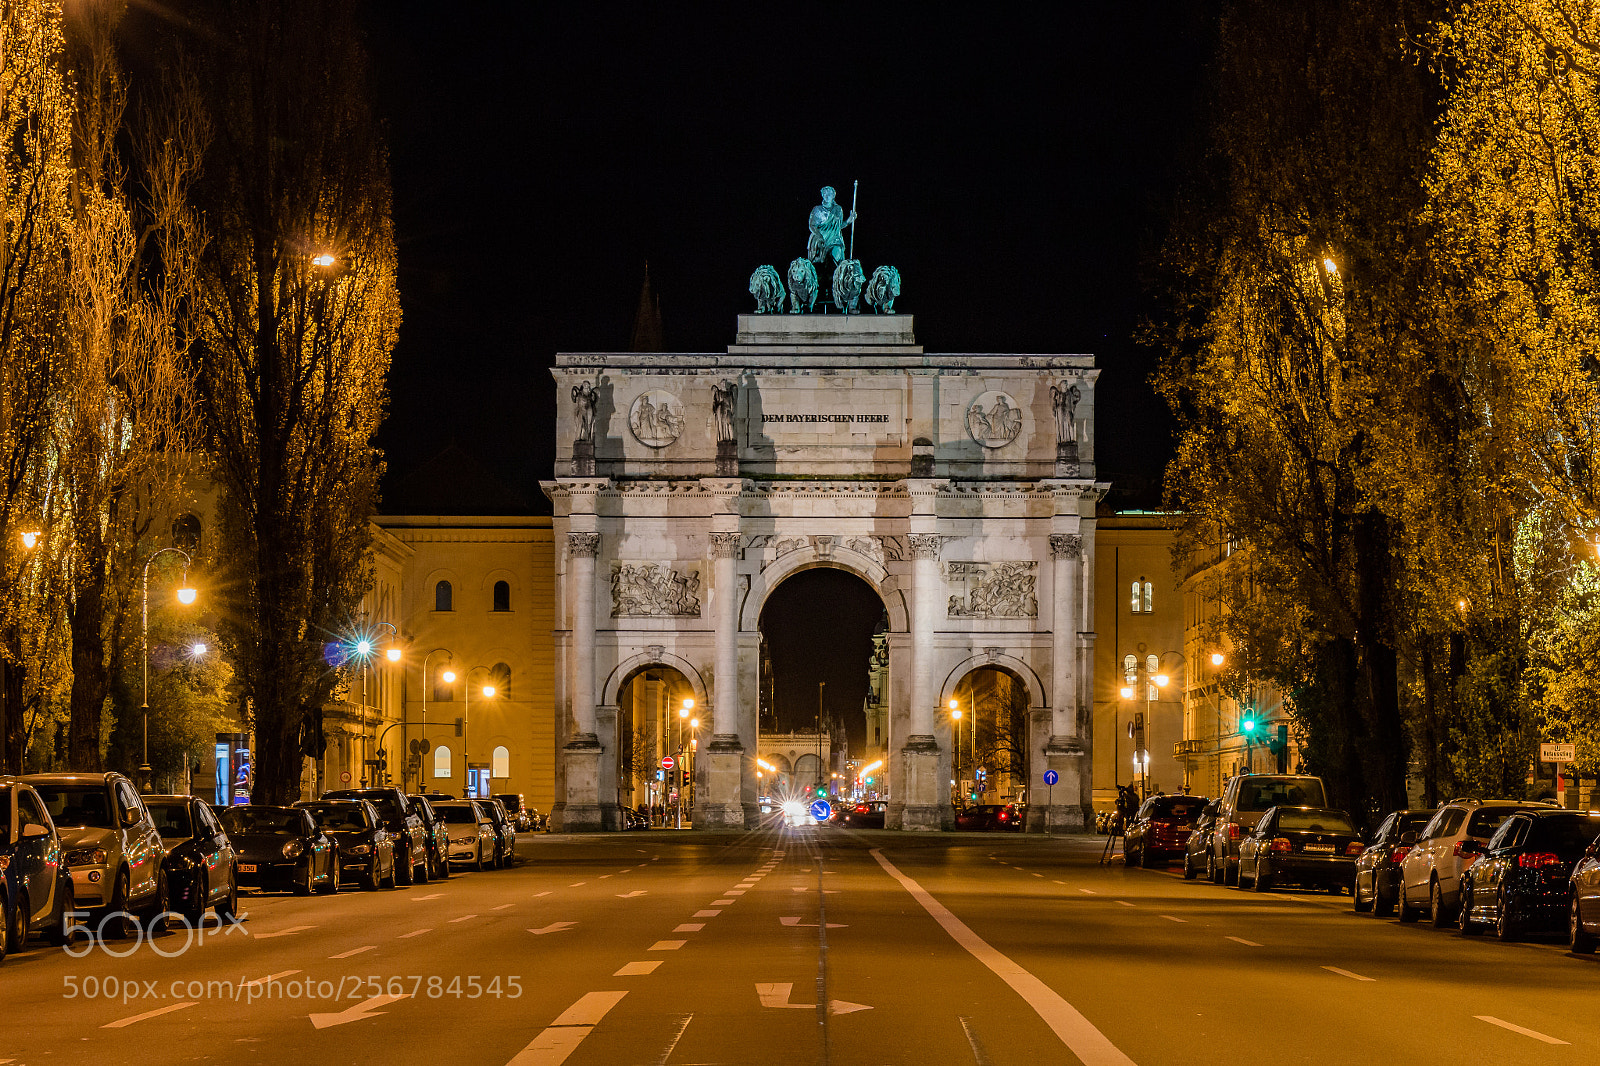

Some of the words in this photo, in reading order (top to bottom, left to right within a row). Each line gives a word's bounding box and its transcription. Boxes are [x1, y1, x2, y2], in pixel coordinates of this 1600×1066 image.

[761, 414, 784, 423] DEM
[786, 414, 854, 423] BAYERISCHEN
[856, 414, 889, 423] HEERE
